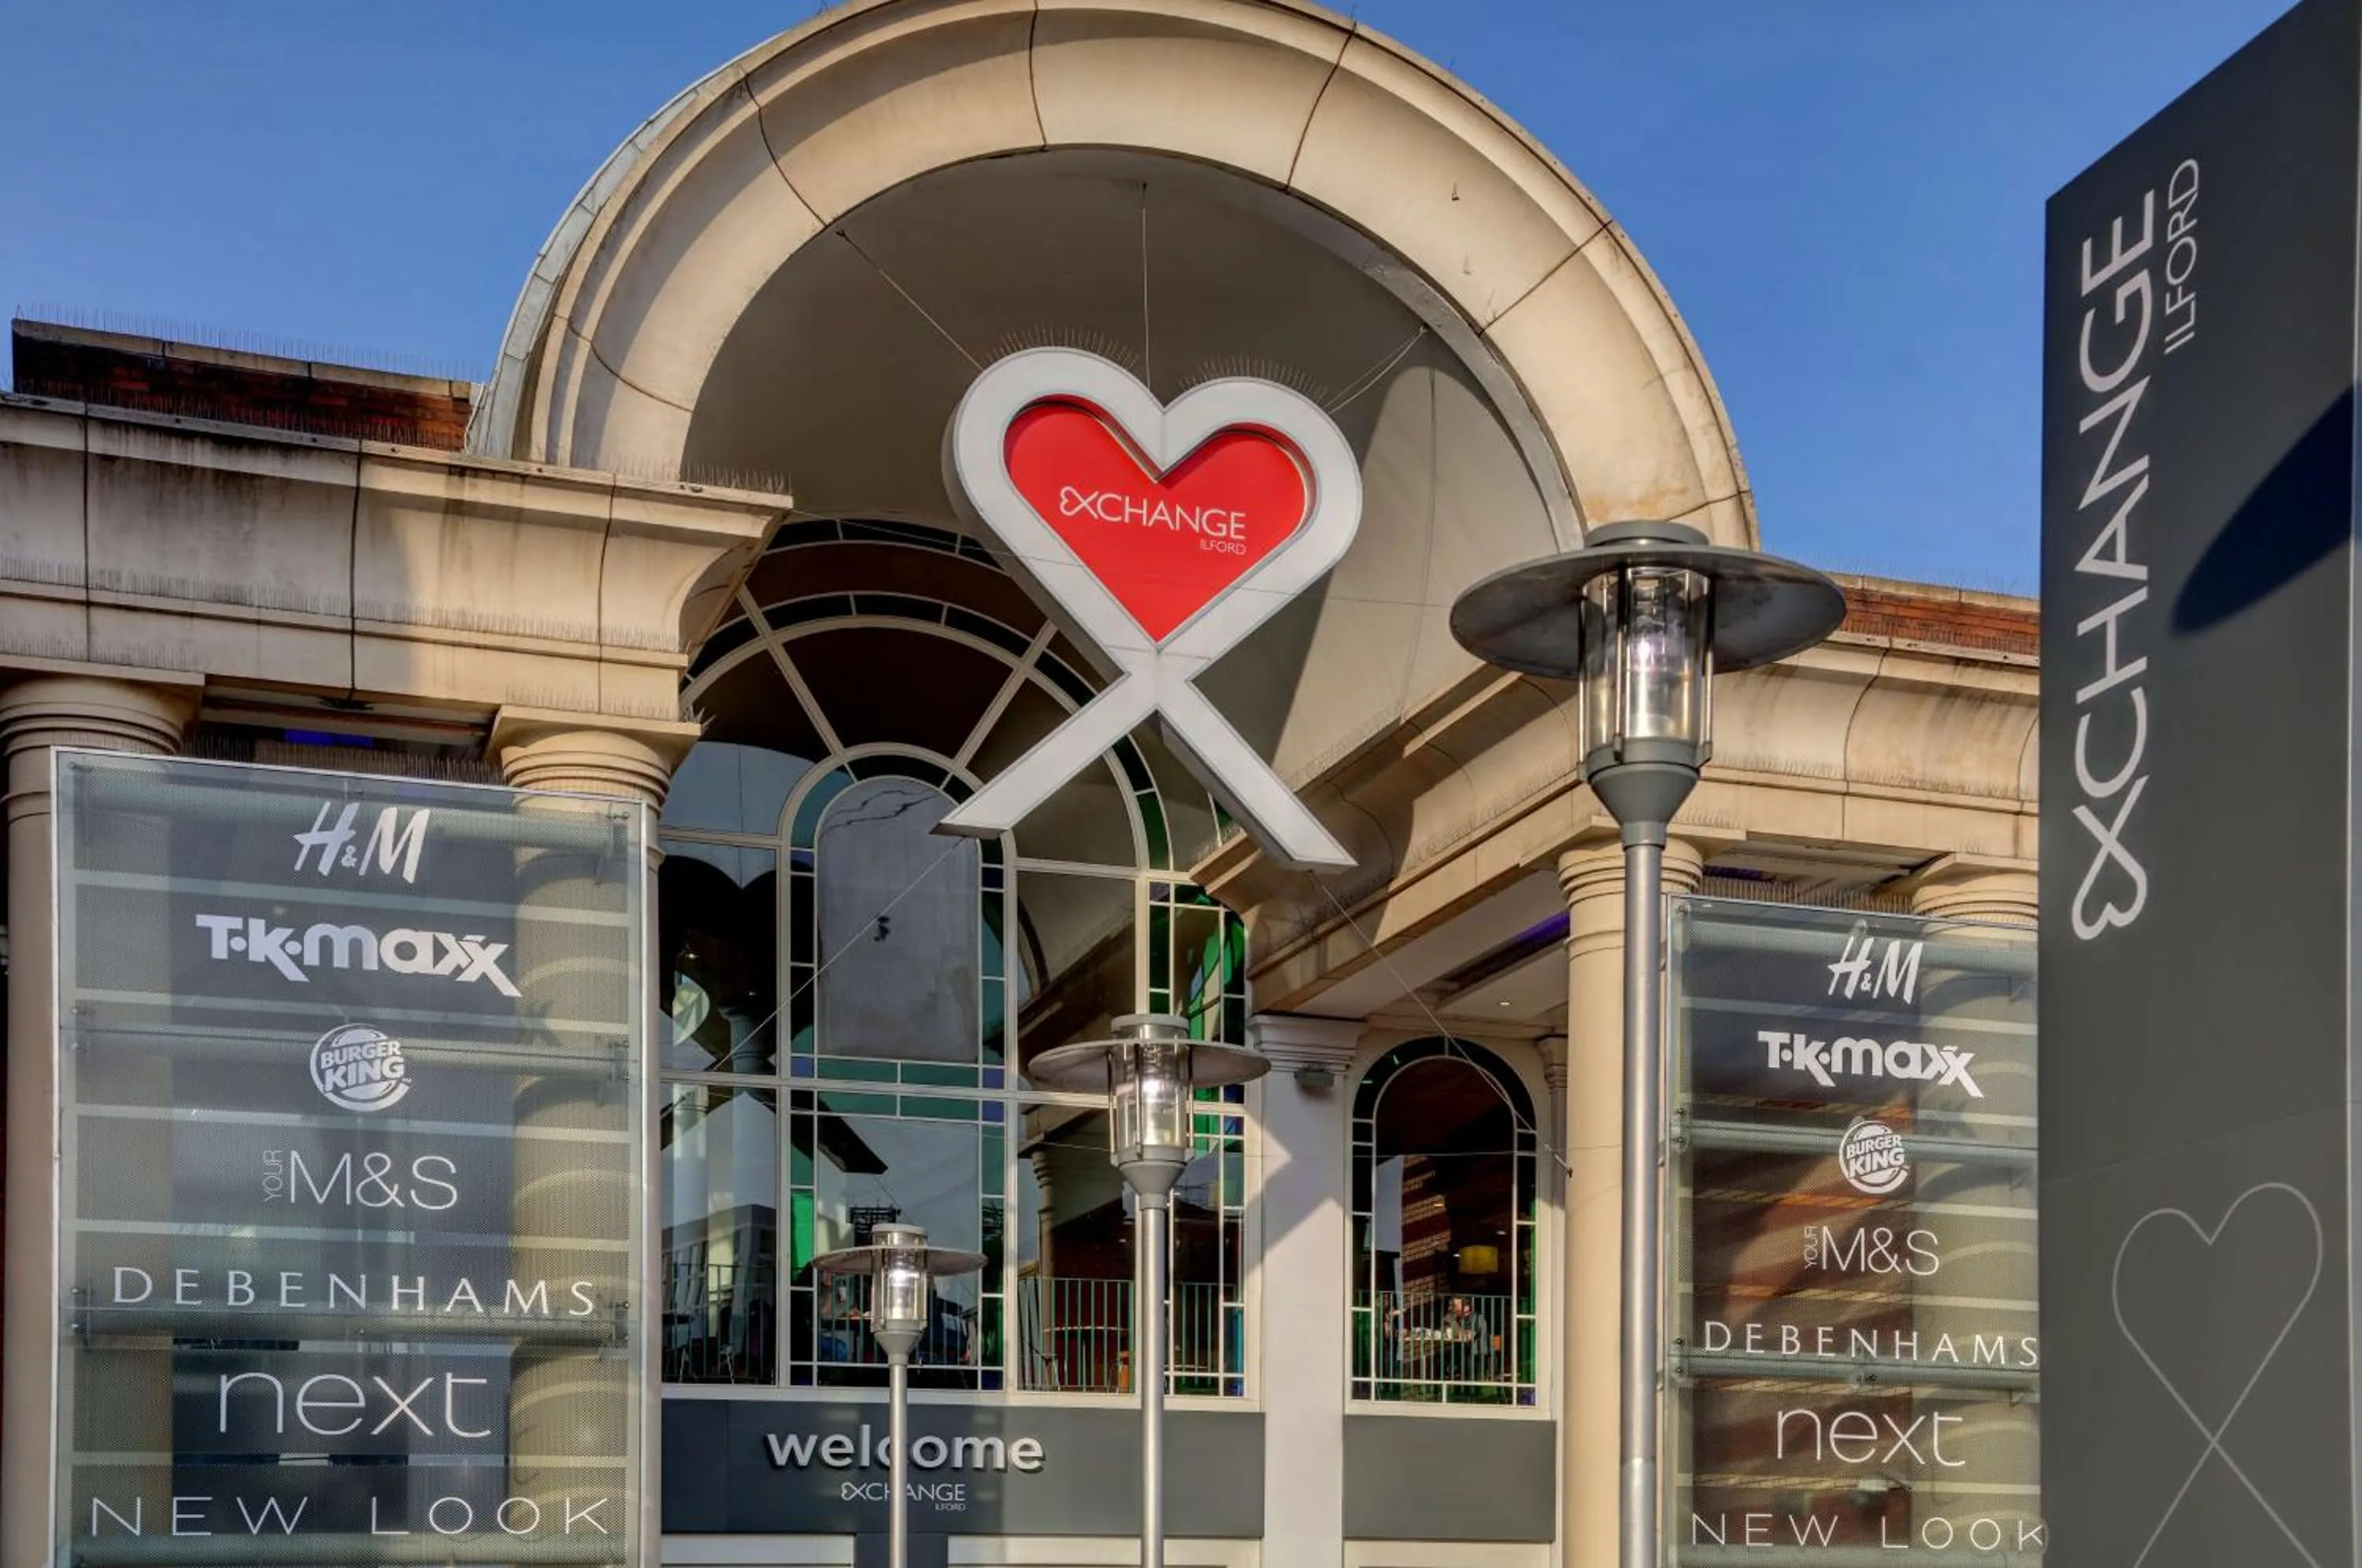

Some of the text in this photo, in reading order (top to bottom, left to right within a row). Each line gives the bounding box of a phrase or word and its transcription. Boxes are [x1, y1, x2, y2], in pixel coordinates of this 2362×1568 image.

[2164, 157, 2199, 356] ILFORD
[1199, 538, 1246, 555] ILFORD
[293, 801, 431, 884] H&M
[1827, 937, 1923, 1004] H&M
[320, 1040, 402, 1069] BURGER
[324, 1056, 405, 1092] KING
[1846, 1134, 1902, 1159] BURGER
[1849, 1148, 1905, 1178] KING
[264, 1149, 458, 1210] YOUR M&S
[1804, 1226, 1940, 1276] YOUR M&S
[113, 1267, 594, 1315] DEBENHAMS
[1705, 1321, 2038, 1366] DEBENHAMS
[219, 1371, 491, 1438] next
[1776, 1409, 1966, 1466] next
[91, 1496, 609, 1537] NEW LOOK
[1692, 1513, 2044, 1551] NEW LOOK
